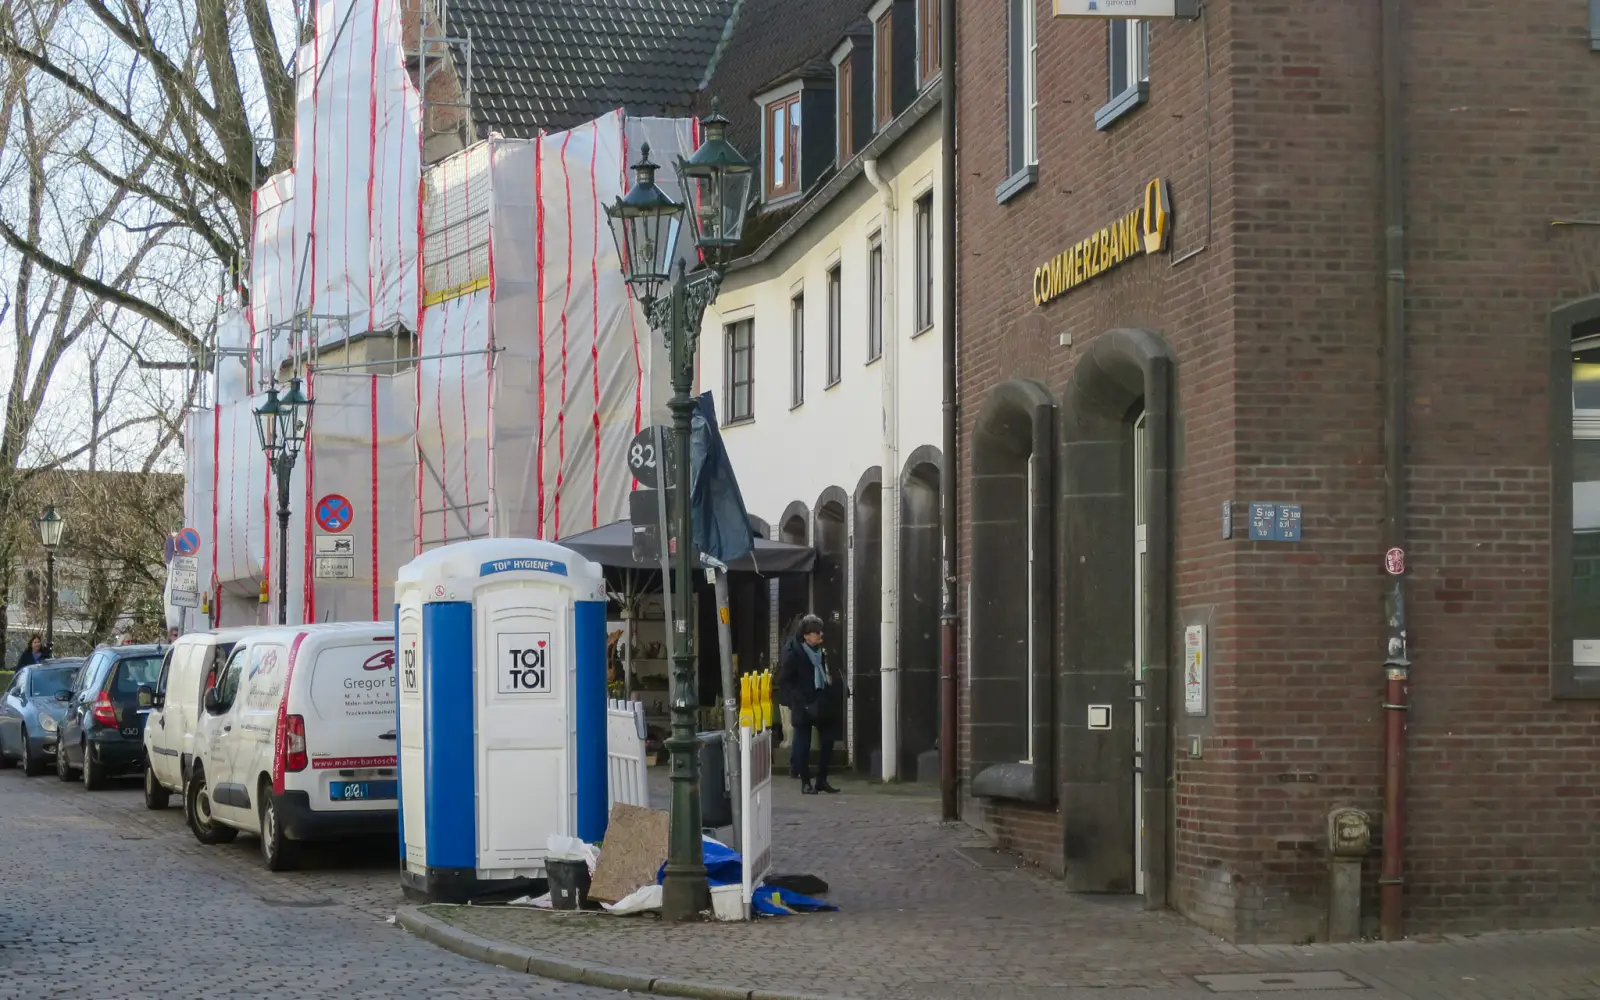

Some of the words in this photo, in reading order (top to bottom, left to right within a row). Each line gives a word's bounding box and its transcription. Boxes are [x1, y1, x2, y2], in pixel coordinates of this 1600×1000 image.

[1033, 207, 1140, 307] COMMERZBANK
[631, 443, 656, 468] 82
[1256, 508, 1263, 517] S
[1282, 509, 1289, 518] S
[404, 649, 416, 669] TOI
[509, 648, 545, 669] TOI
[343, 678, 386, 691] Gregor
[404, 669, 416, 689] TOI
[509, 669, 545, 689] TOI
